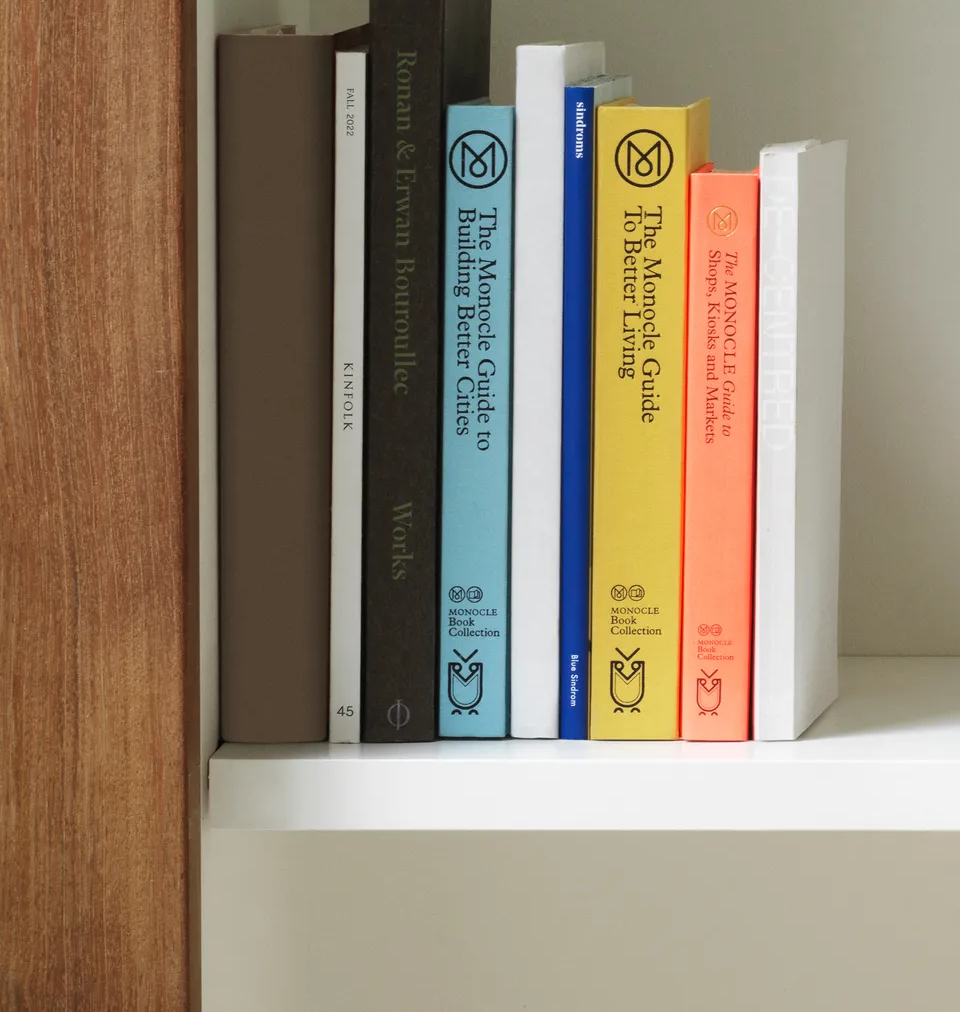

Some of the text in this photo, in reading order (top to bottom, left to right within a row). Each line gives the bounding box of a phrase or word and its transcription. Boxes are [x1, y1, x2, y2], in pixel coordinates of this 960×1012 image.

[346, 88, 355, 137] FALL 2022
[575, 101, 587, 159] sindroms
[394, 51, 418, 395] Ronan & Erwan Bouroullec
[618, 205, 642, 379] To Better Living
[641, 205, 662, 423] The Monocle Guide
[453, 207, 477, 436] Building Better Cities
[477, 207, 497, 451] The Monocle Guide to
[705, 249, 721, 444] Shops, Kiosks and Markets
[722, 252, 738, 437] The MONOCLE Guide to
[343, 362, 354, 431] KINFOLK
[392, 500, 414, 581] Works
[448, 608, 498, 617] MONOCLE
[448, 617, 475, 627] Book
[448, 627, 500, 637] Collection
[610, 607, 660, 615] MONOCLE
[610, 615, 637, 625] Book
[610, 626, 662, 635] Collection
[570, 654, 579, 707] Blue Sindrom
[336, 706, 354, 717] 45
